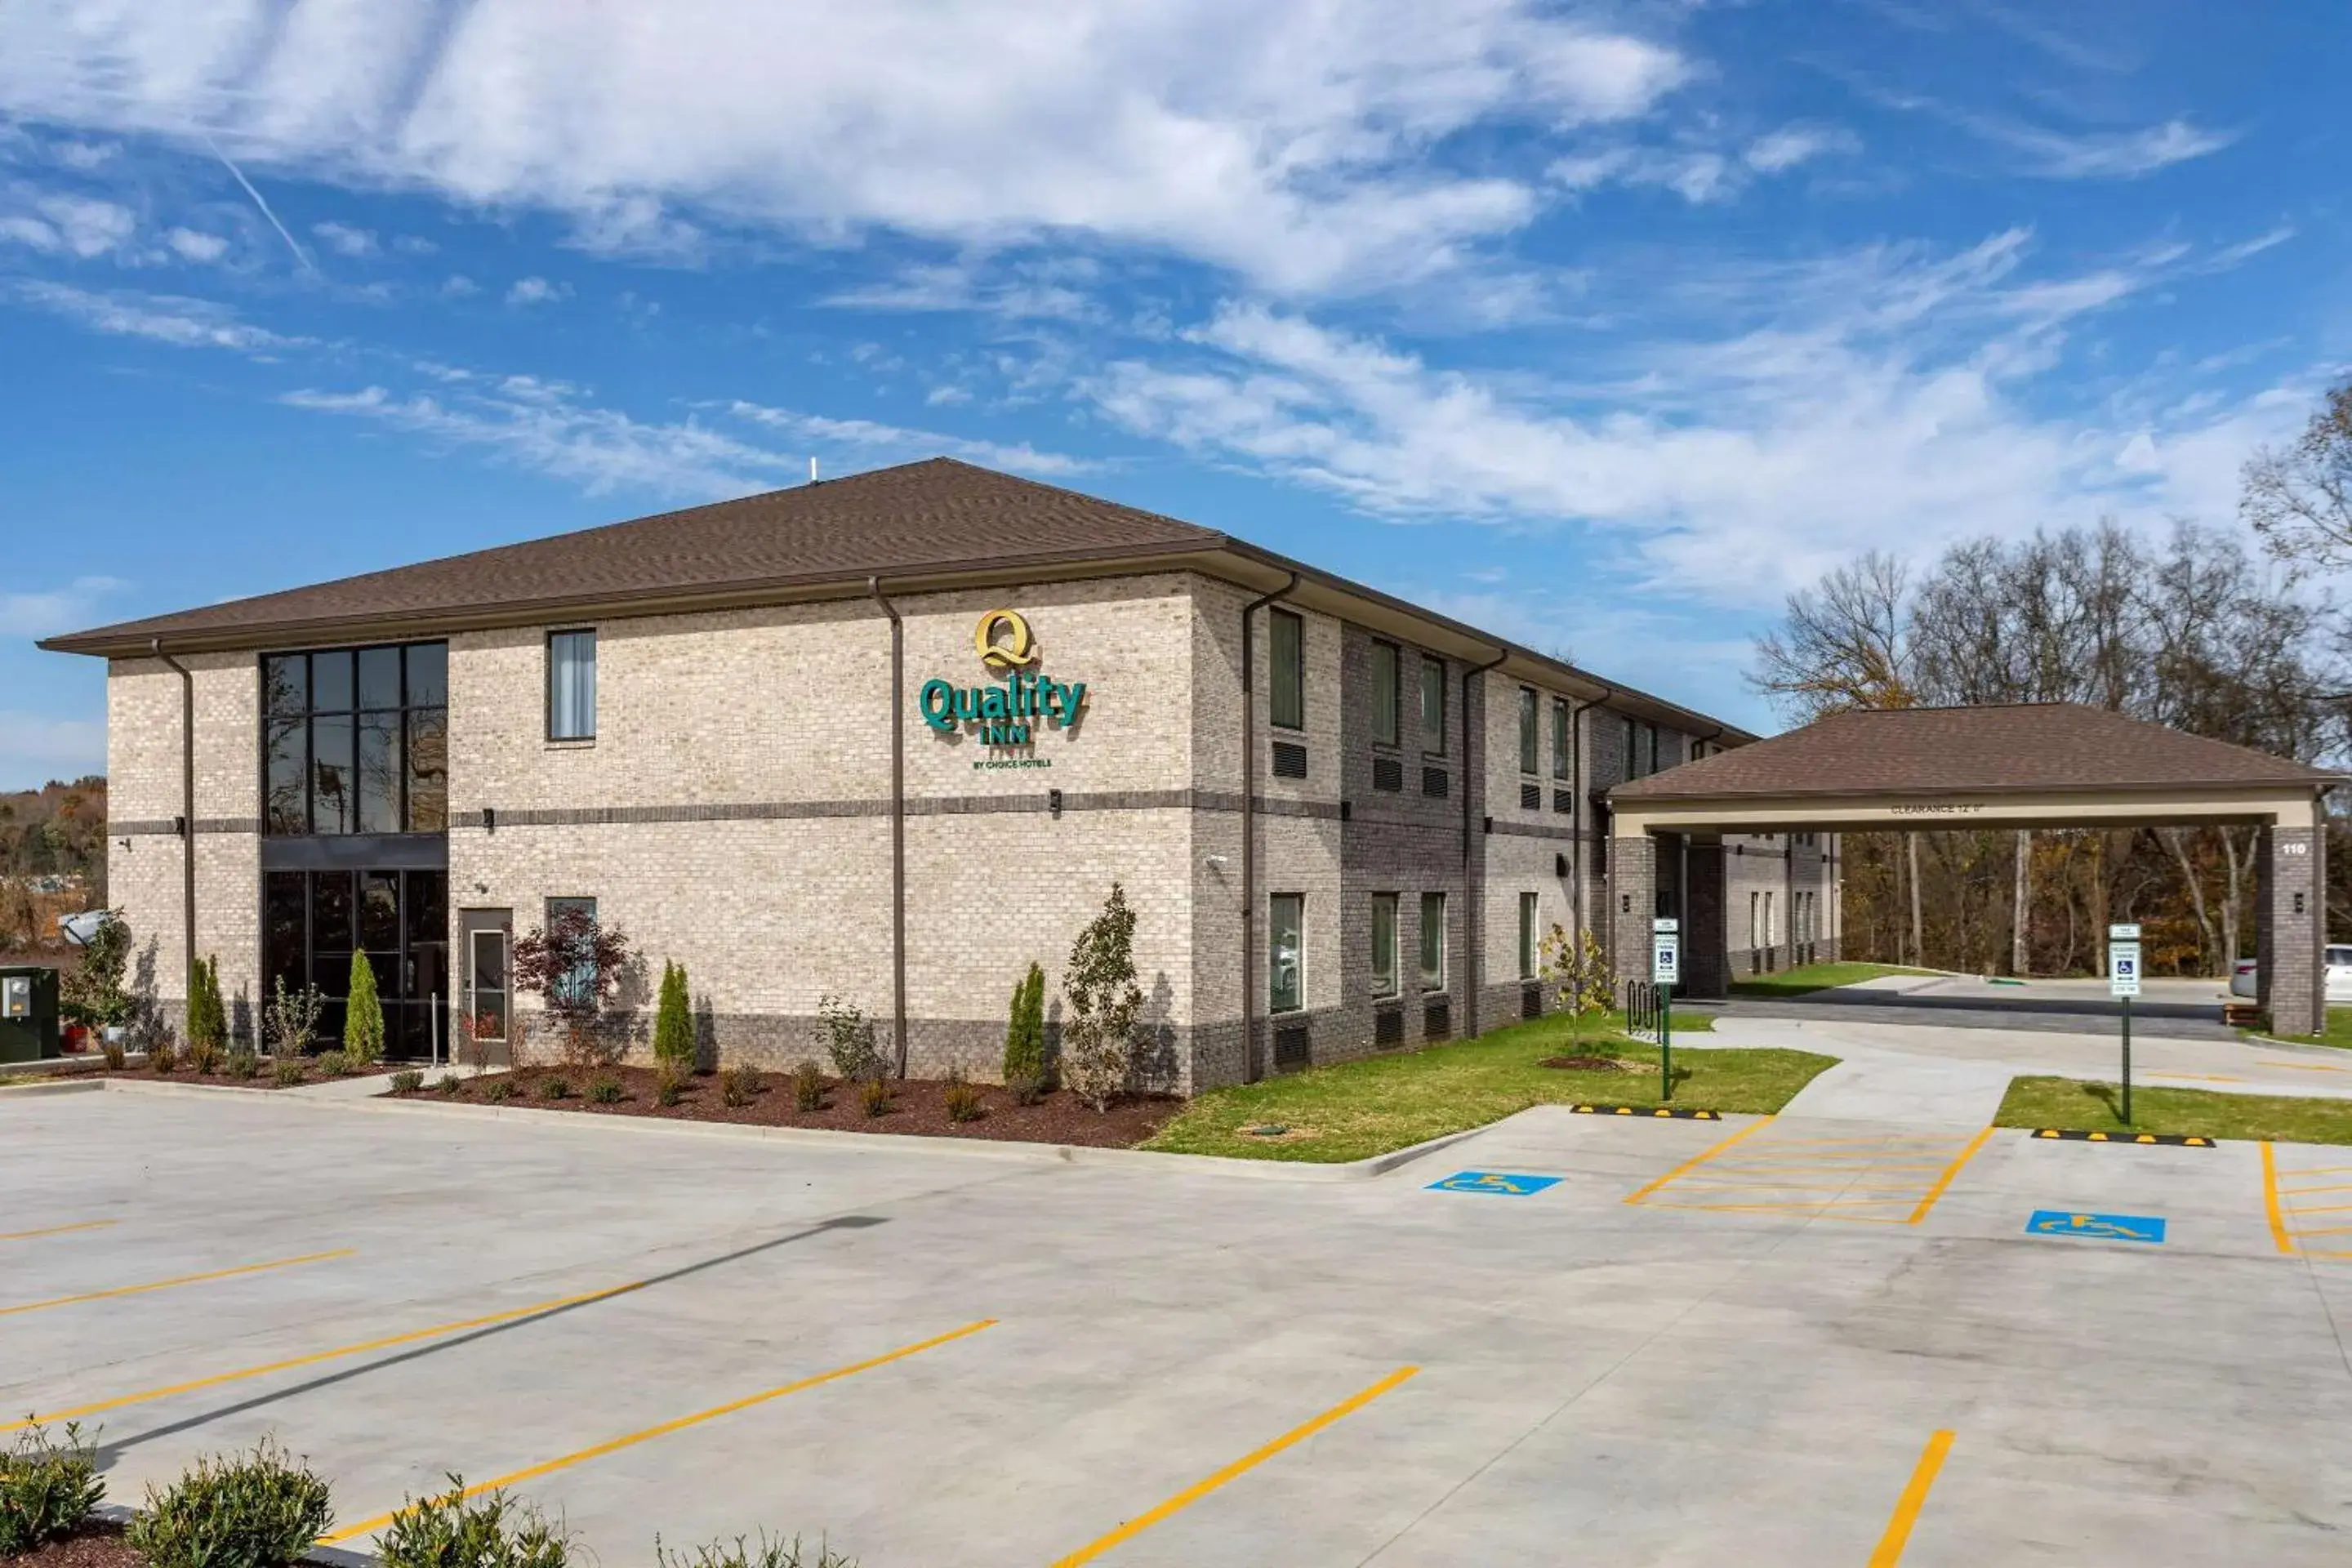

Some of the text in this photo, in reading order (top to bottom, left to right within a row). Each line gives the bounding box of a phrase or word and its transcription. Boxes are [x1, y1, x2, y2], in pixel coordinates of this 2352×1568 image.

[975, 608, 1033, 666] Q
[920, 674, 1087, 732] Quality
[980, 725, 1031, 745] INN
[973, 759, 1052, 770] BY CHOICE HOTELS
[1891, 804, 1954, 814] CLEARANCE
[2283, 843, 2306, 855] 110
